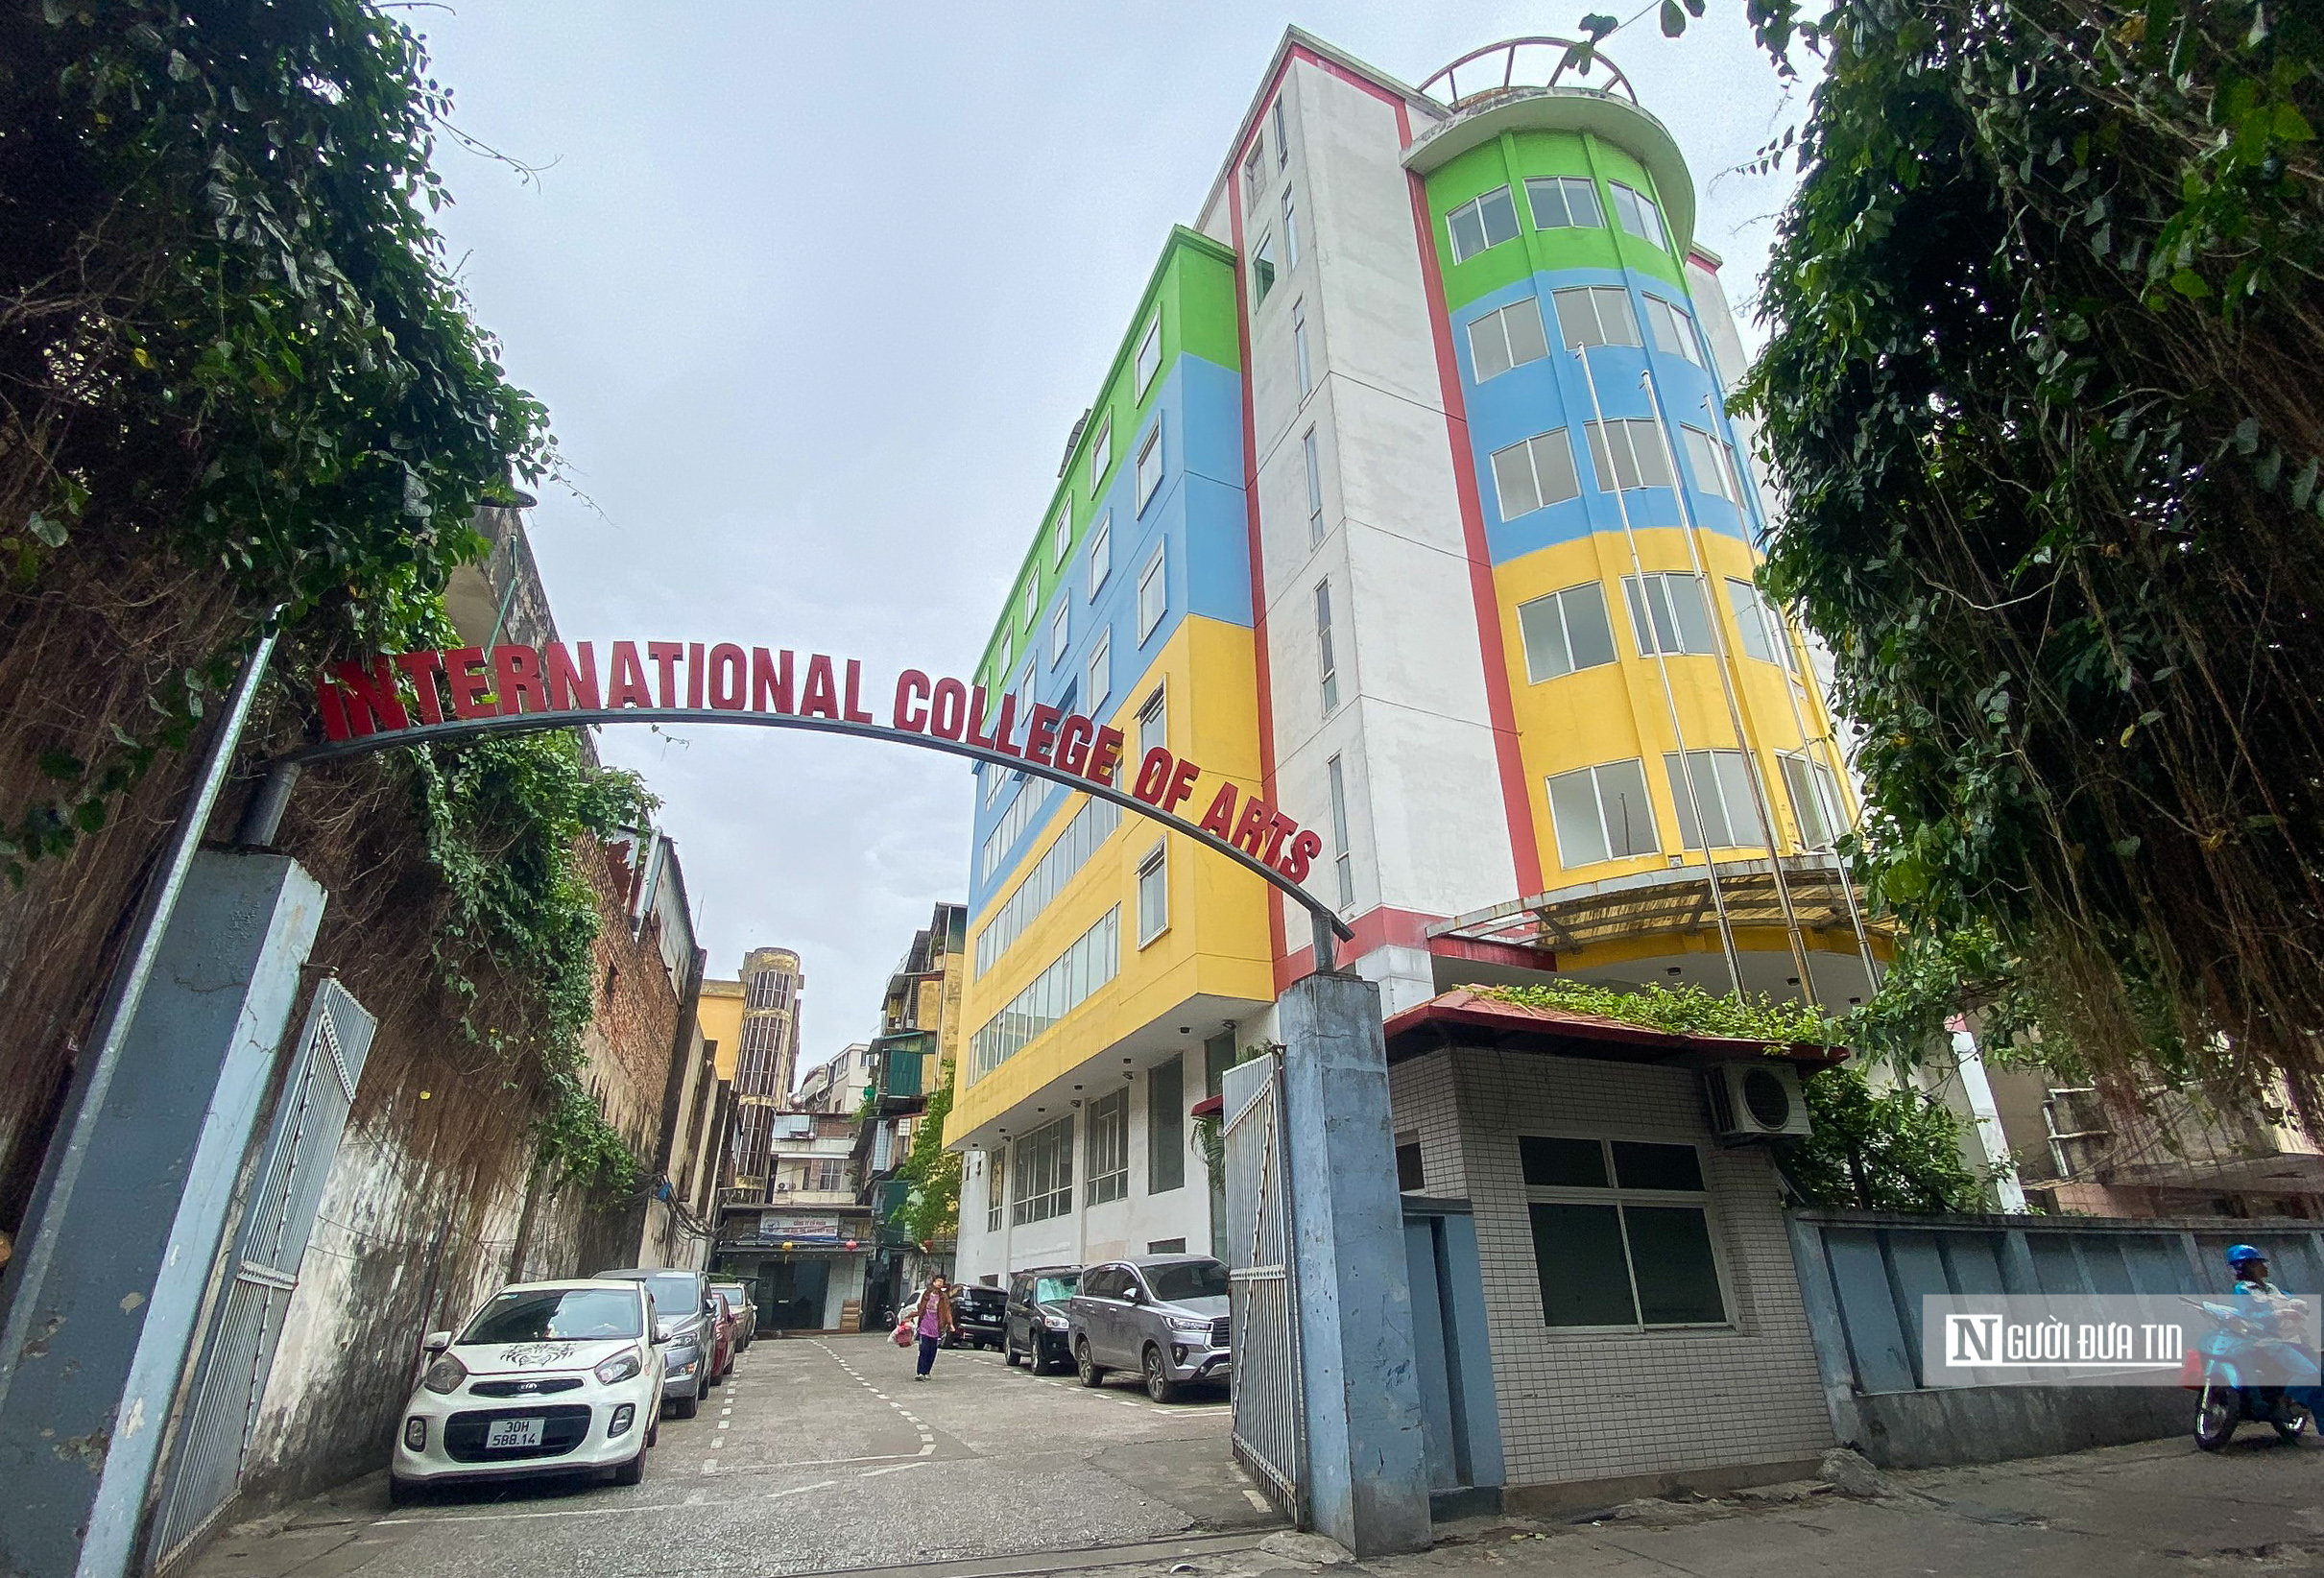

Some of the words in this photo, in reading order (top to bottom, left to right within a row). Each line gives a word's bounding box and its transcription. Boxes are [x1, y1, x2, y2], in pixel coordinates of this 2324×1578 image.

[321, 640, 873, 741] INTERNATIONAL
[893, 669, 1125, 787] COLLEGE
[1132, 746, 1201, 813] OF
[1200, 781, 1323, 885] ARTS
[504, 1421, 530, 1433] 30H
